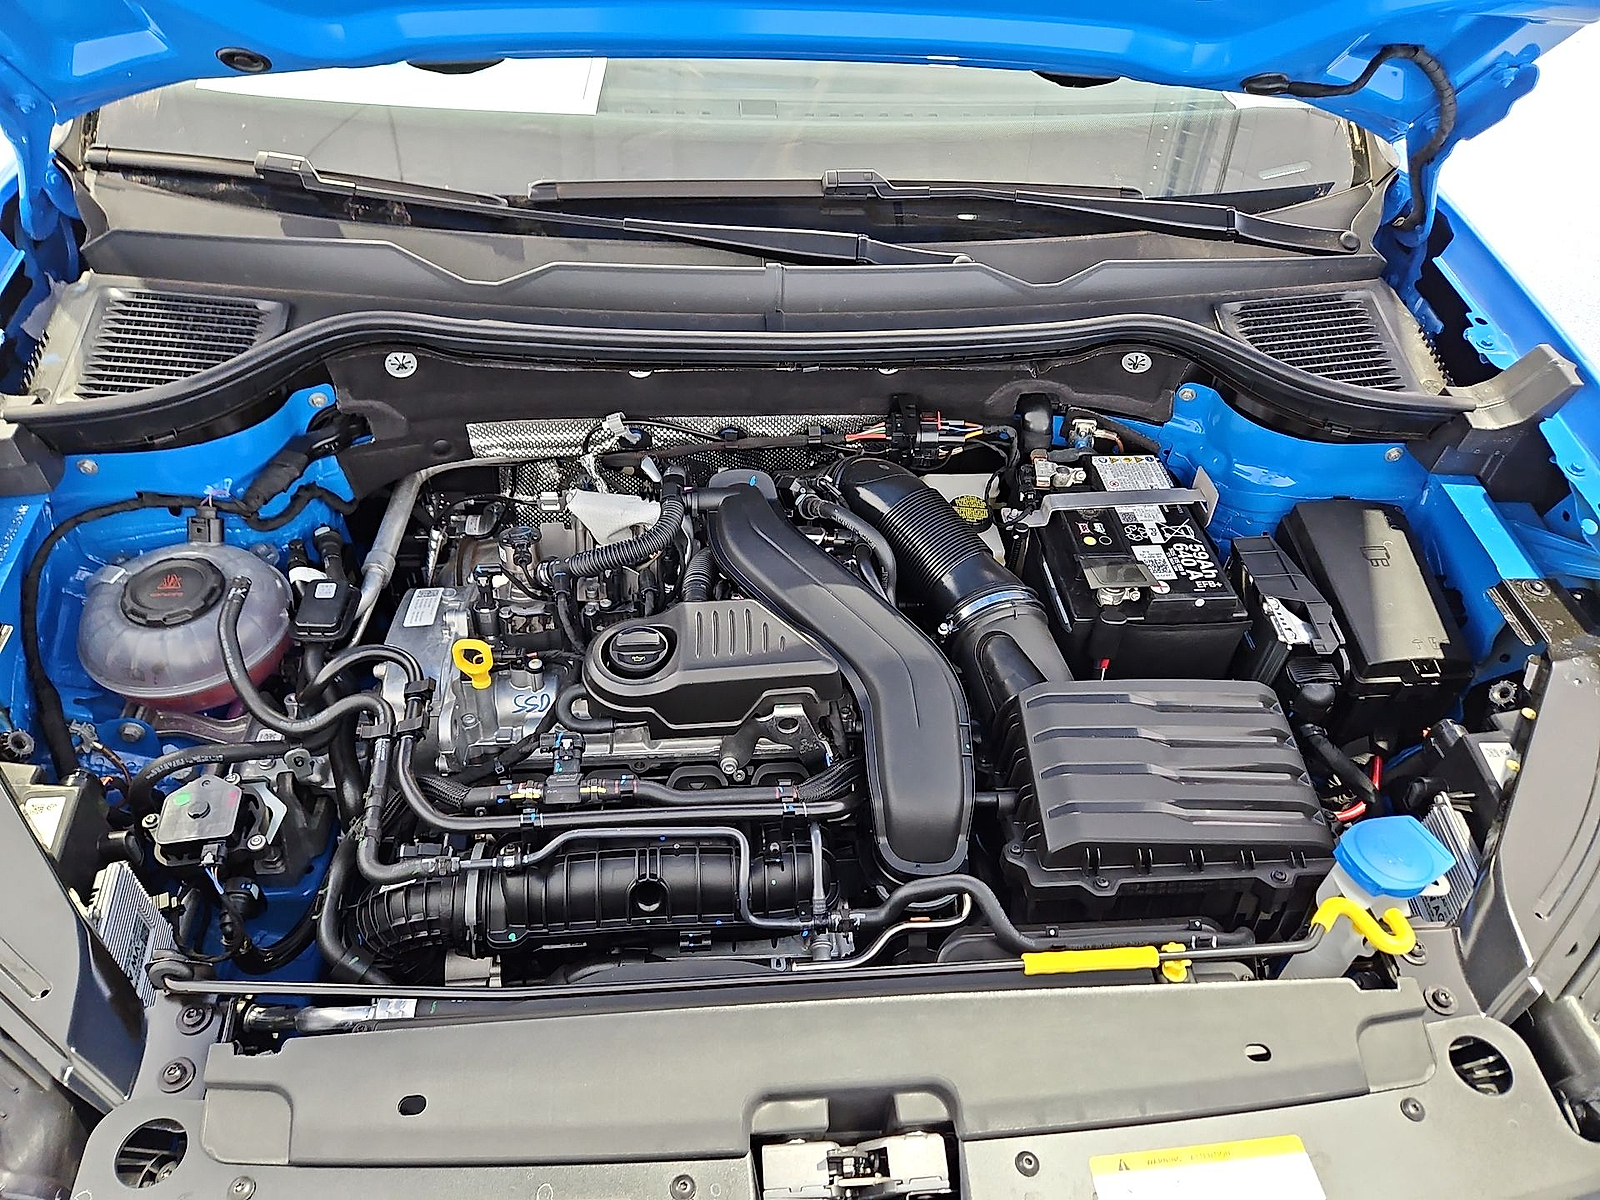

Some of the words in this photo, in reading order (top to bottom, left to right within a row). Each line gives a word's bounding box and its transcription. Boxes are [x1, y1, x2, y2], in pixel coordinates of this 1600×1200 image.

[1172, 543, 1198, 567] 640
[1185, 569, 1204, 581] A
[1188, 543, 1219, 579] 59Ah
[1195, 580, 1223, 588] EFB+
